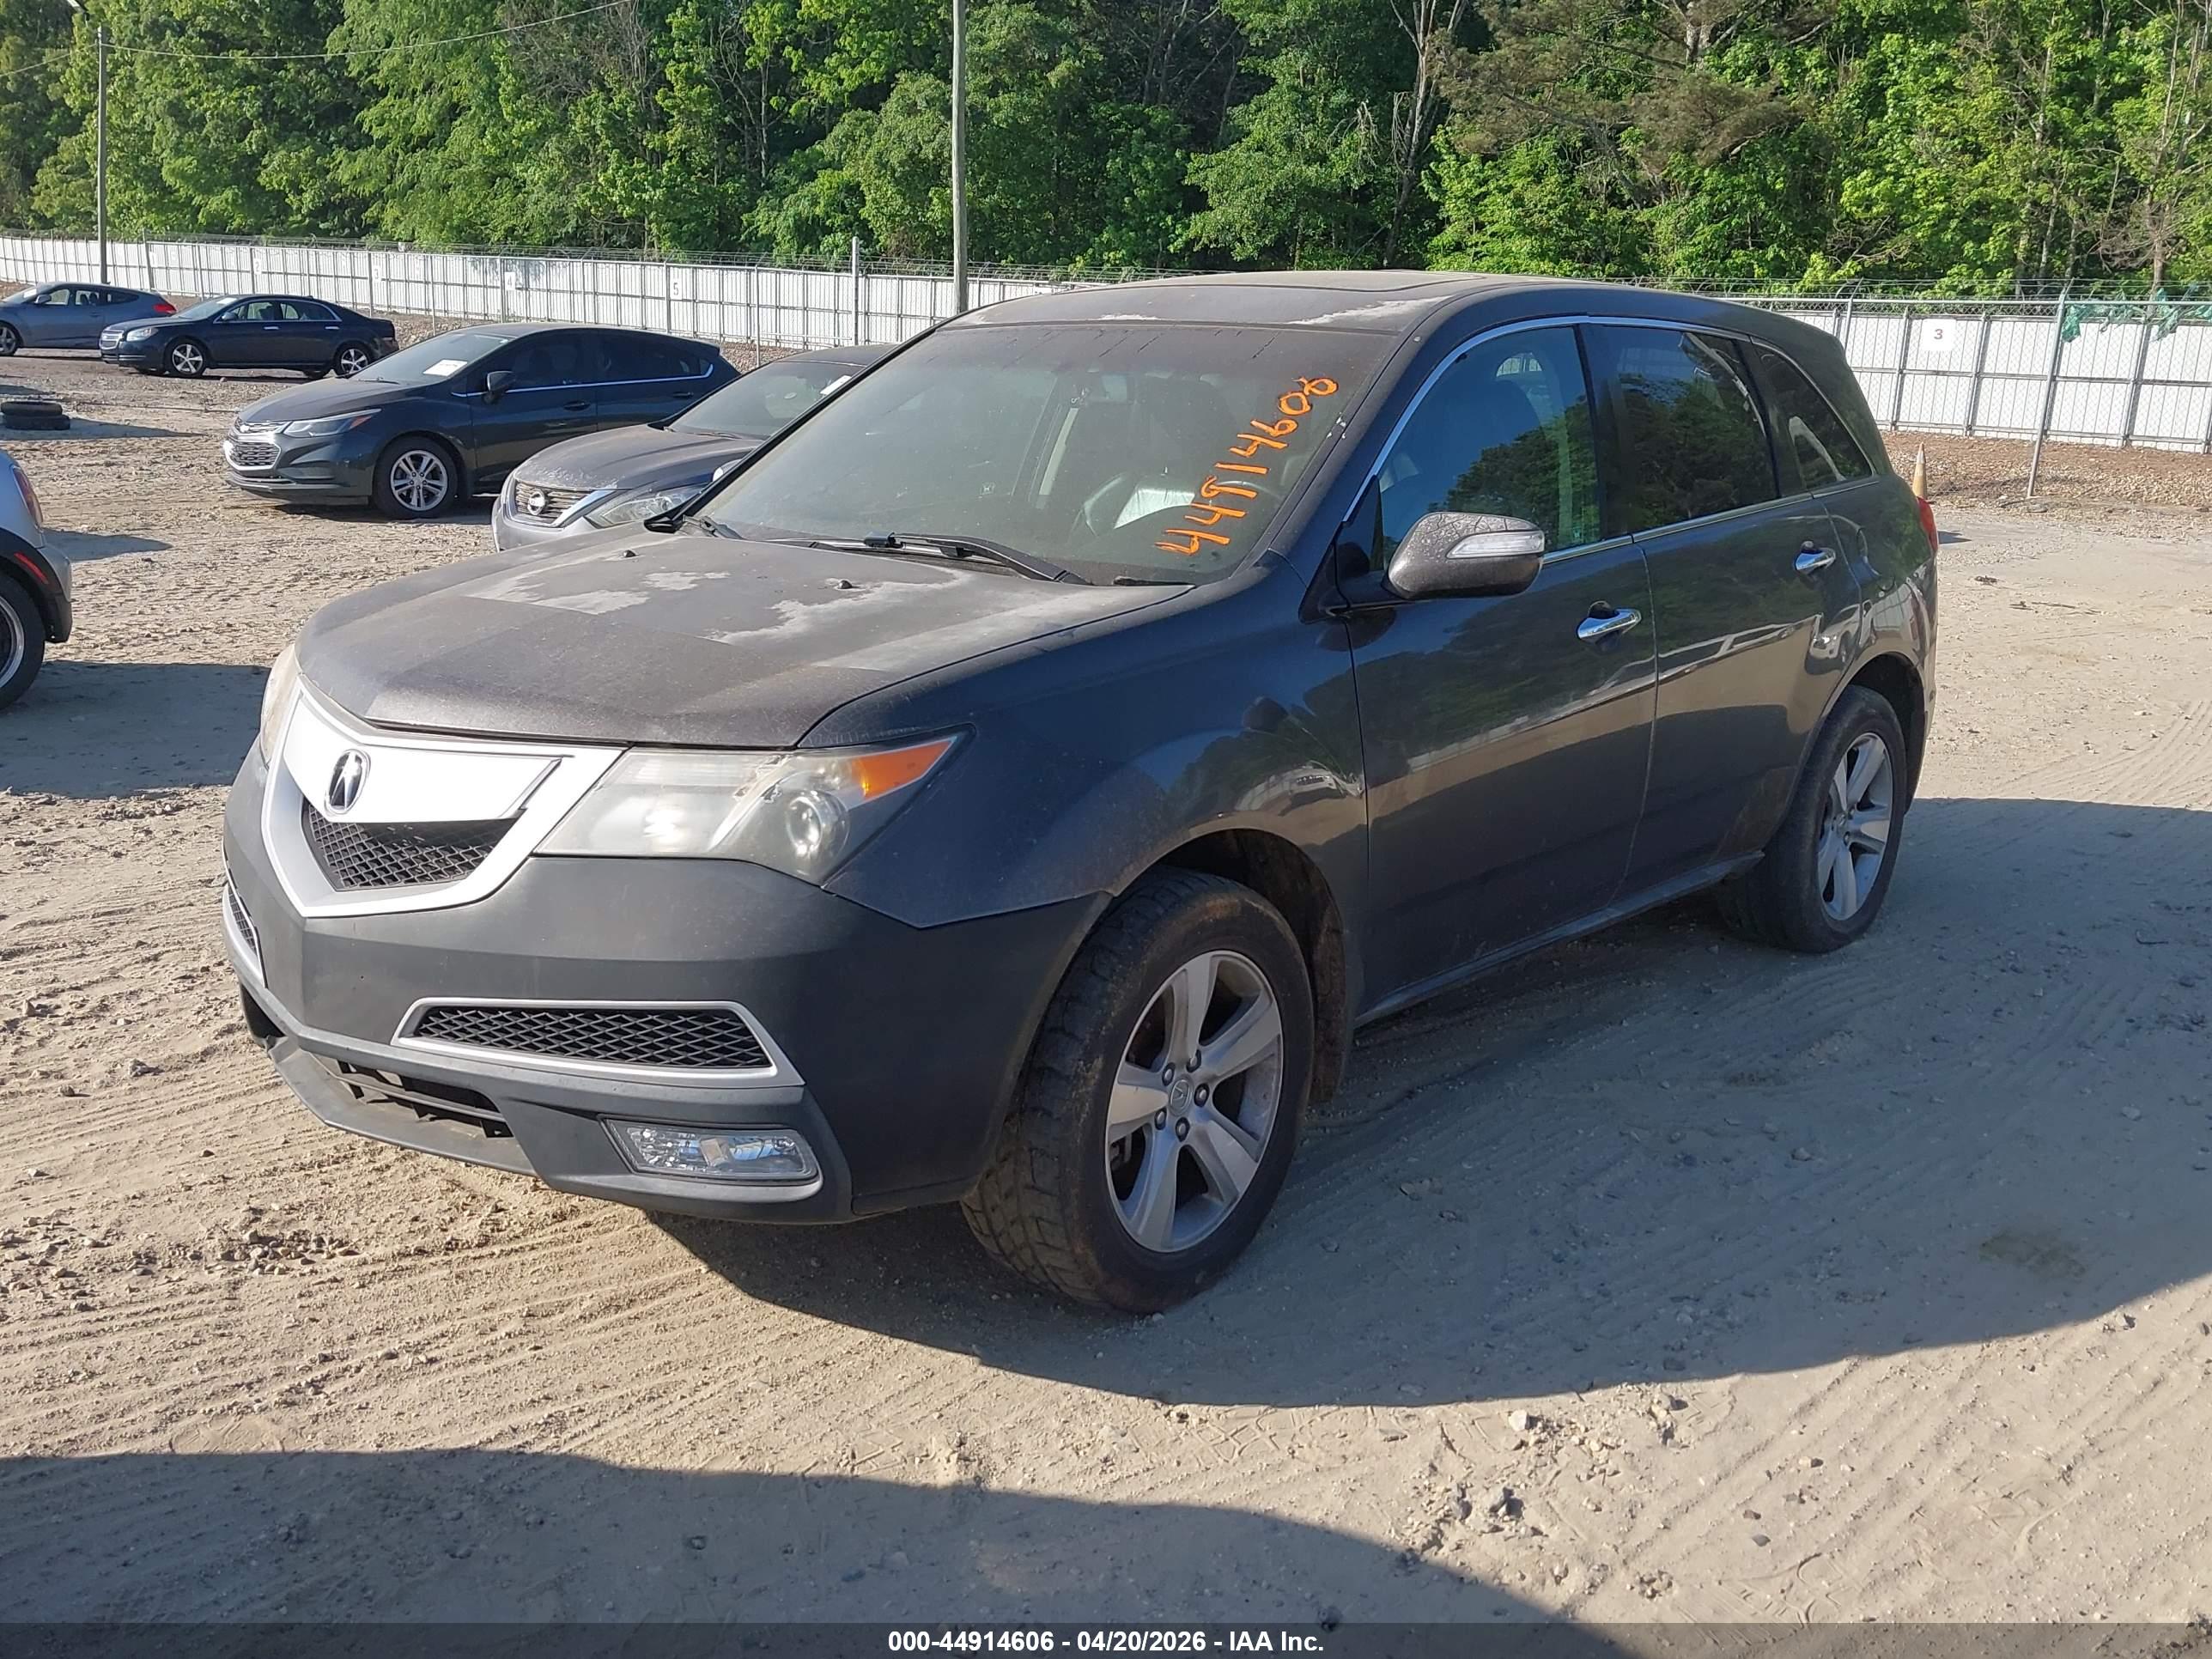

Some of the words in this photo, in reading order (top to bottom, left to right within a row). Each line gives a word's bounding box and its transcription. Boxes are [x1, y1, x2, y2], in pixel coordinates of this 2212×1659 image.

[507, 275, 513, 287] 4
[673, 282, 678, 295] 5
[1933, 328, 1943, 340] 3
